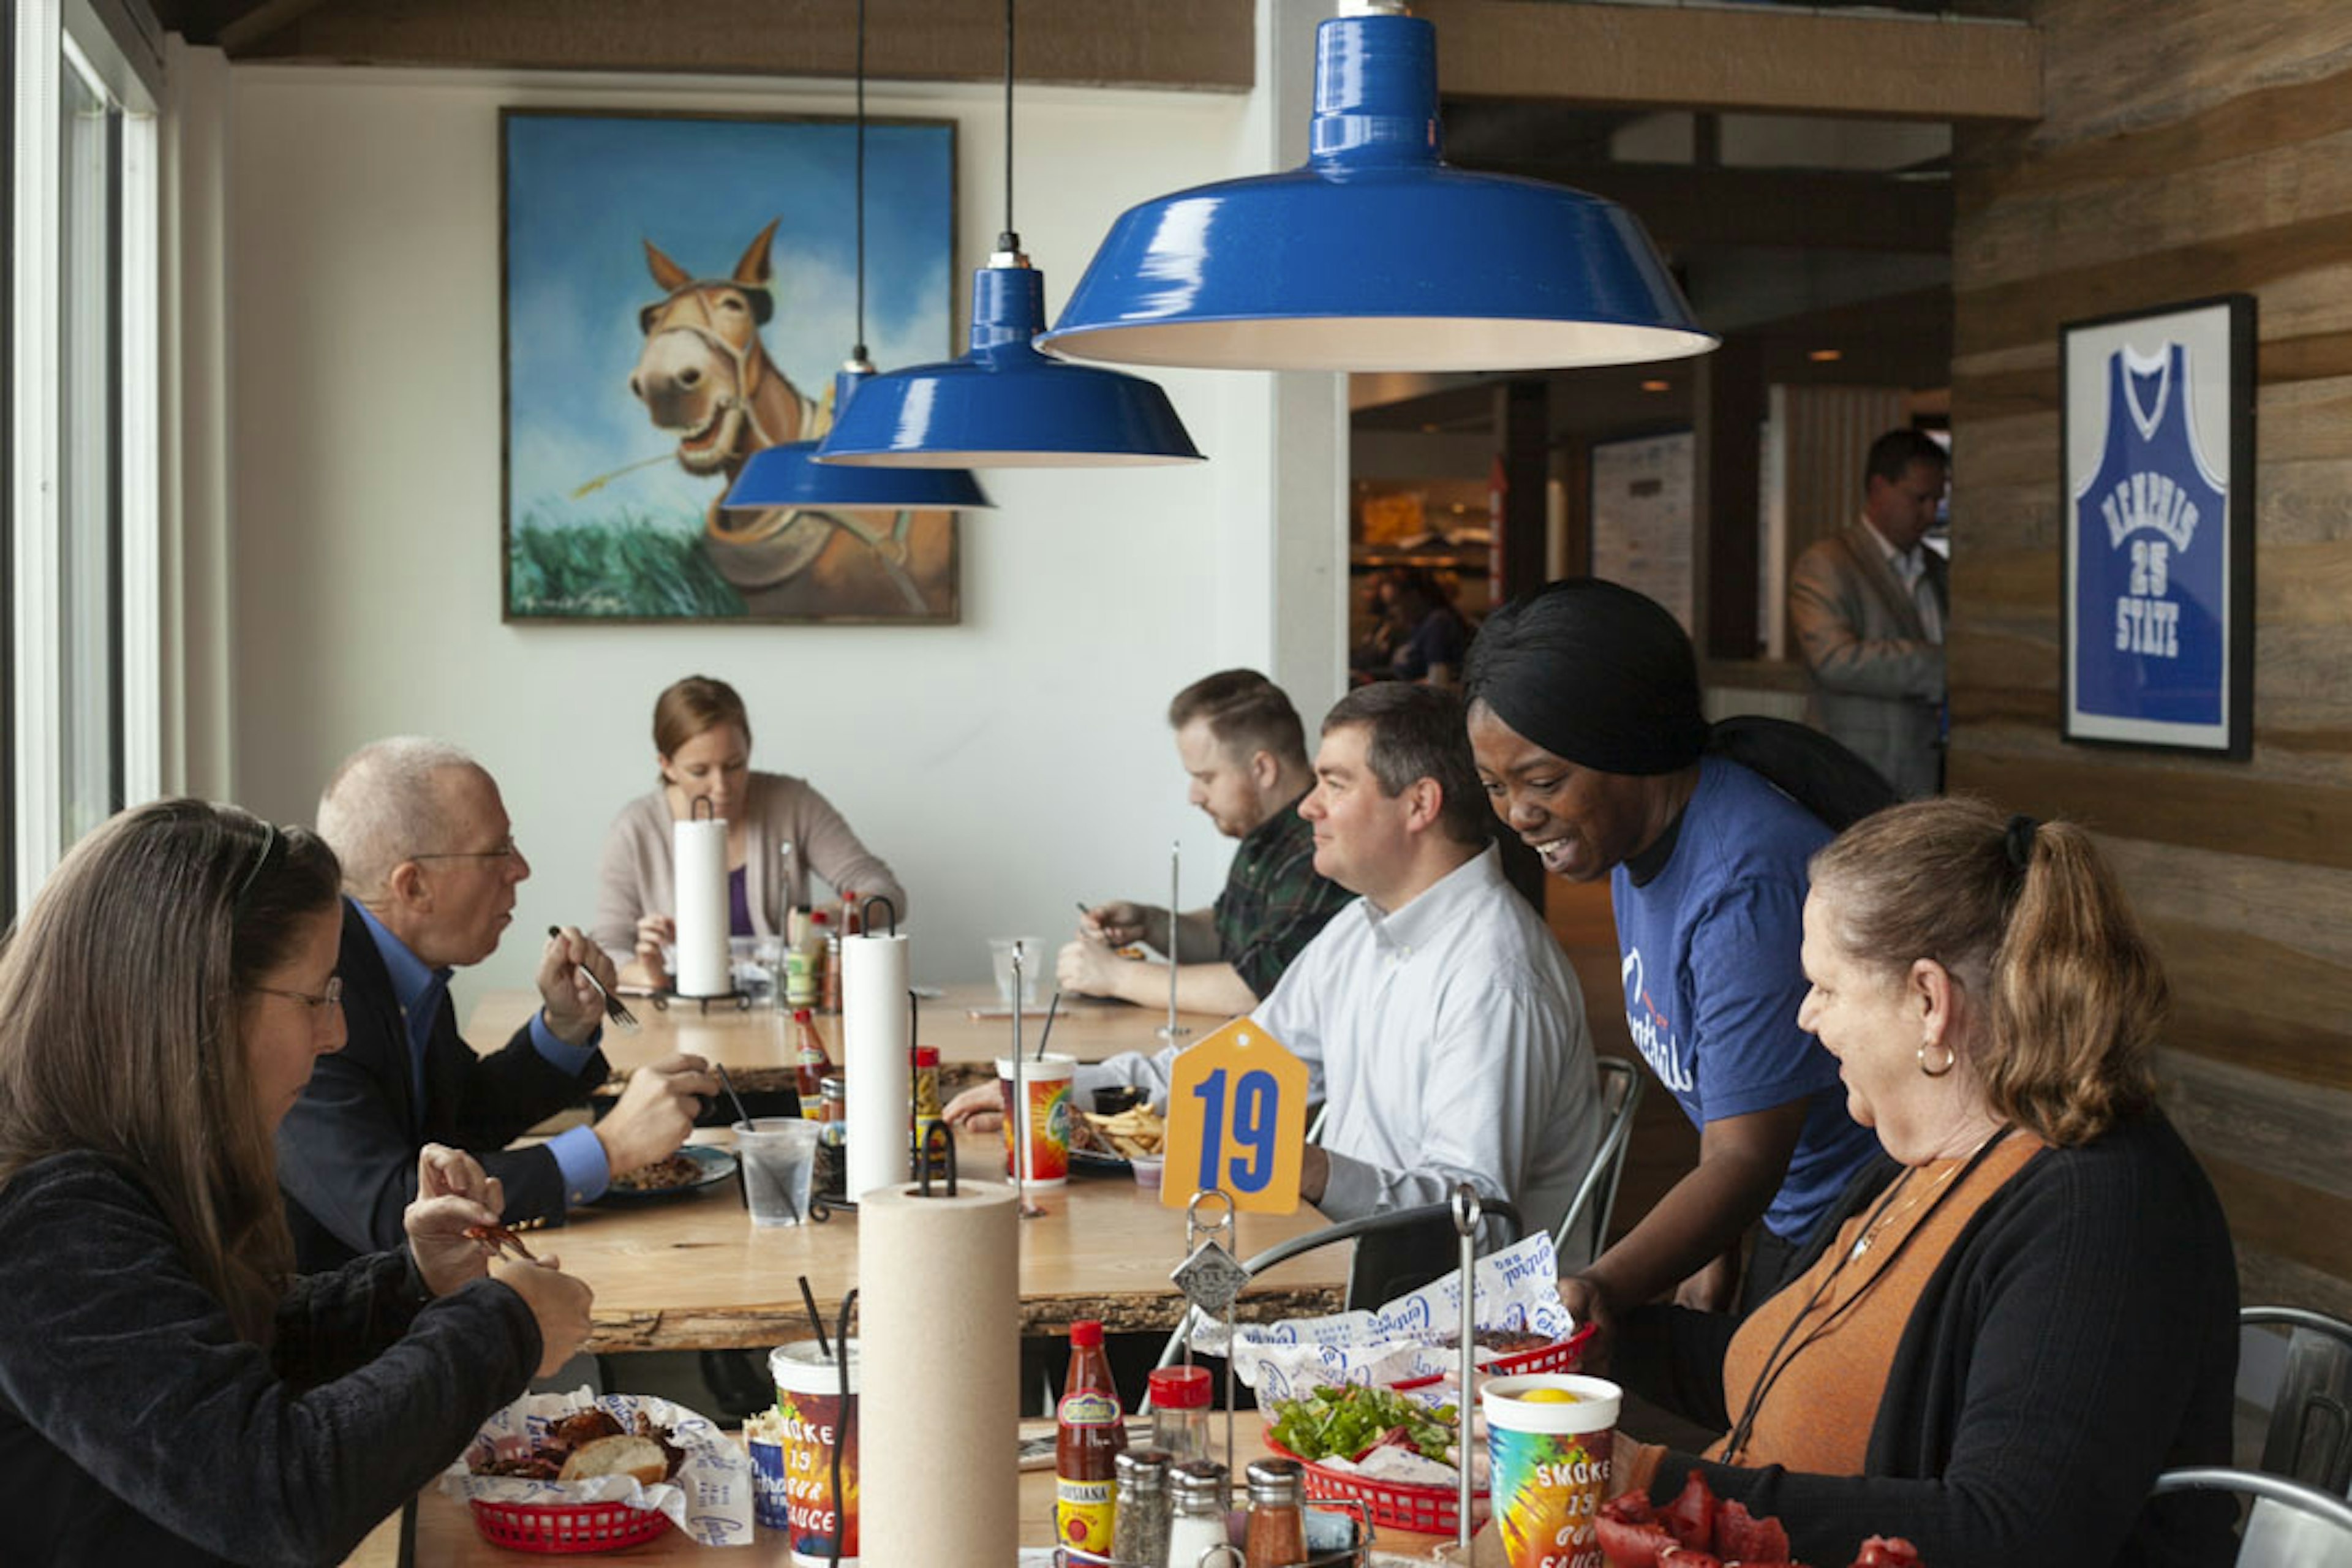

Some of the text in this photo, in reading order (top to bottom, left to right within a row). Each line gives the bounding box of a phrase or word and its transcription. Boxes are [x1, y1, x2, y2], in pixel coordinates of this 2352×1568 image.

[2101, 472, 2199, 553] MEMPHIS
[2130, 539, 2168, 598] 25
[2116, 595, 2180, 659] STATE
[1621, 946, 1694, 1091] Cntral
[1193, 1068, 1278, 1193] 19
[790, 1448, 811, 1471] IS
[1537, 1460, 1611, 1487] SMOKE
[788, 1505, 836, 1532] AUCE
[1568, 1493, 1594, 1516] IS
